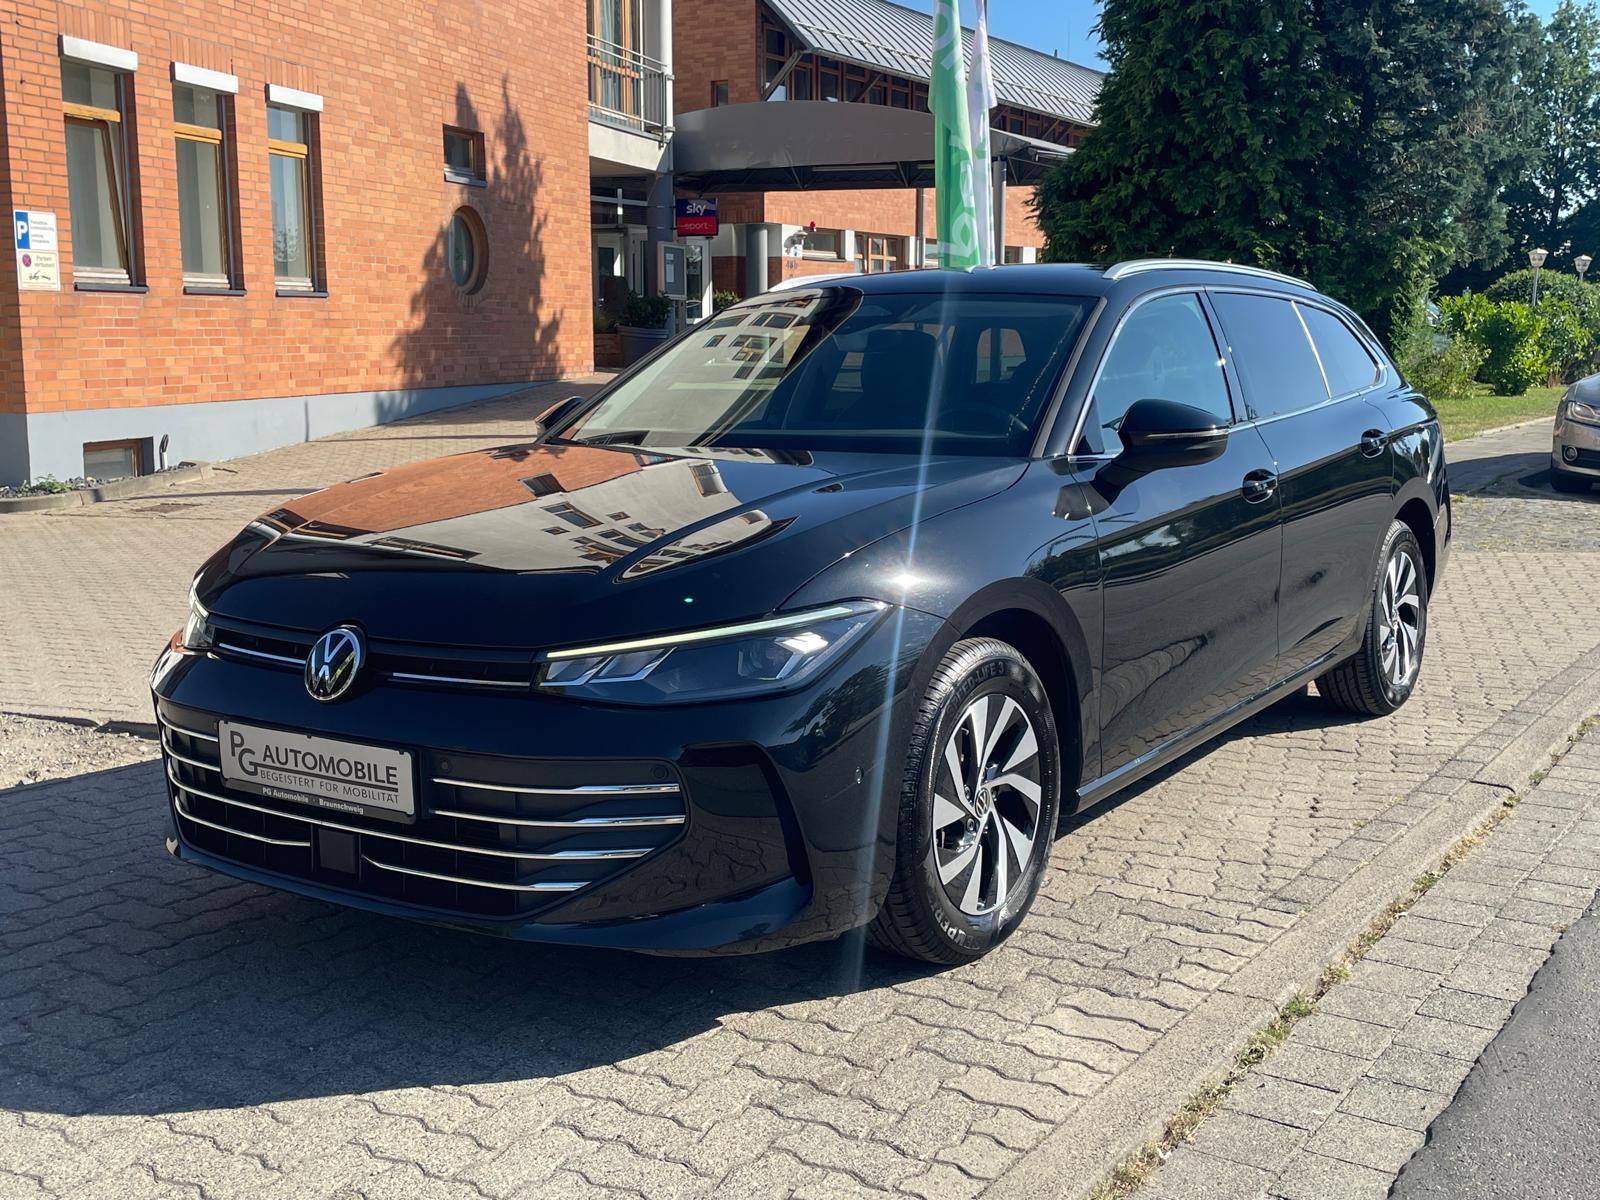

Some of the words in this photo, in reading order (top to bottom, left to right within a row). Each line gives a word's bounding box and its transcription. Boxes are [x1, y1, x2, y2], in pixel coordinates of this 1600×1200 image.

[686, 202, 706, 216] sky
[16, 220, 28, 240] P
[685, 222, 709, 231] sport
[262, 744, 398, 786] AUTOMOBILE
[260, 771, 315, 789] BEGEISTERT
[319, 780, 339, 794] FÜR
[343, 786, 400, 804] MOBILITÄT
[262, 787, 272, 797] PG
[273, 789, 309, 804] Automobile
[319, 798, 364, 815] Braunschweig
